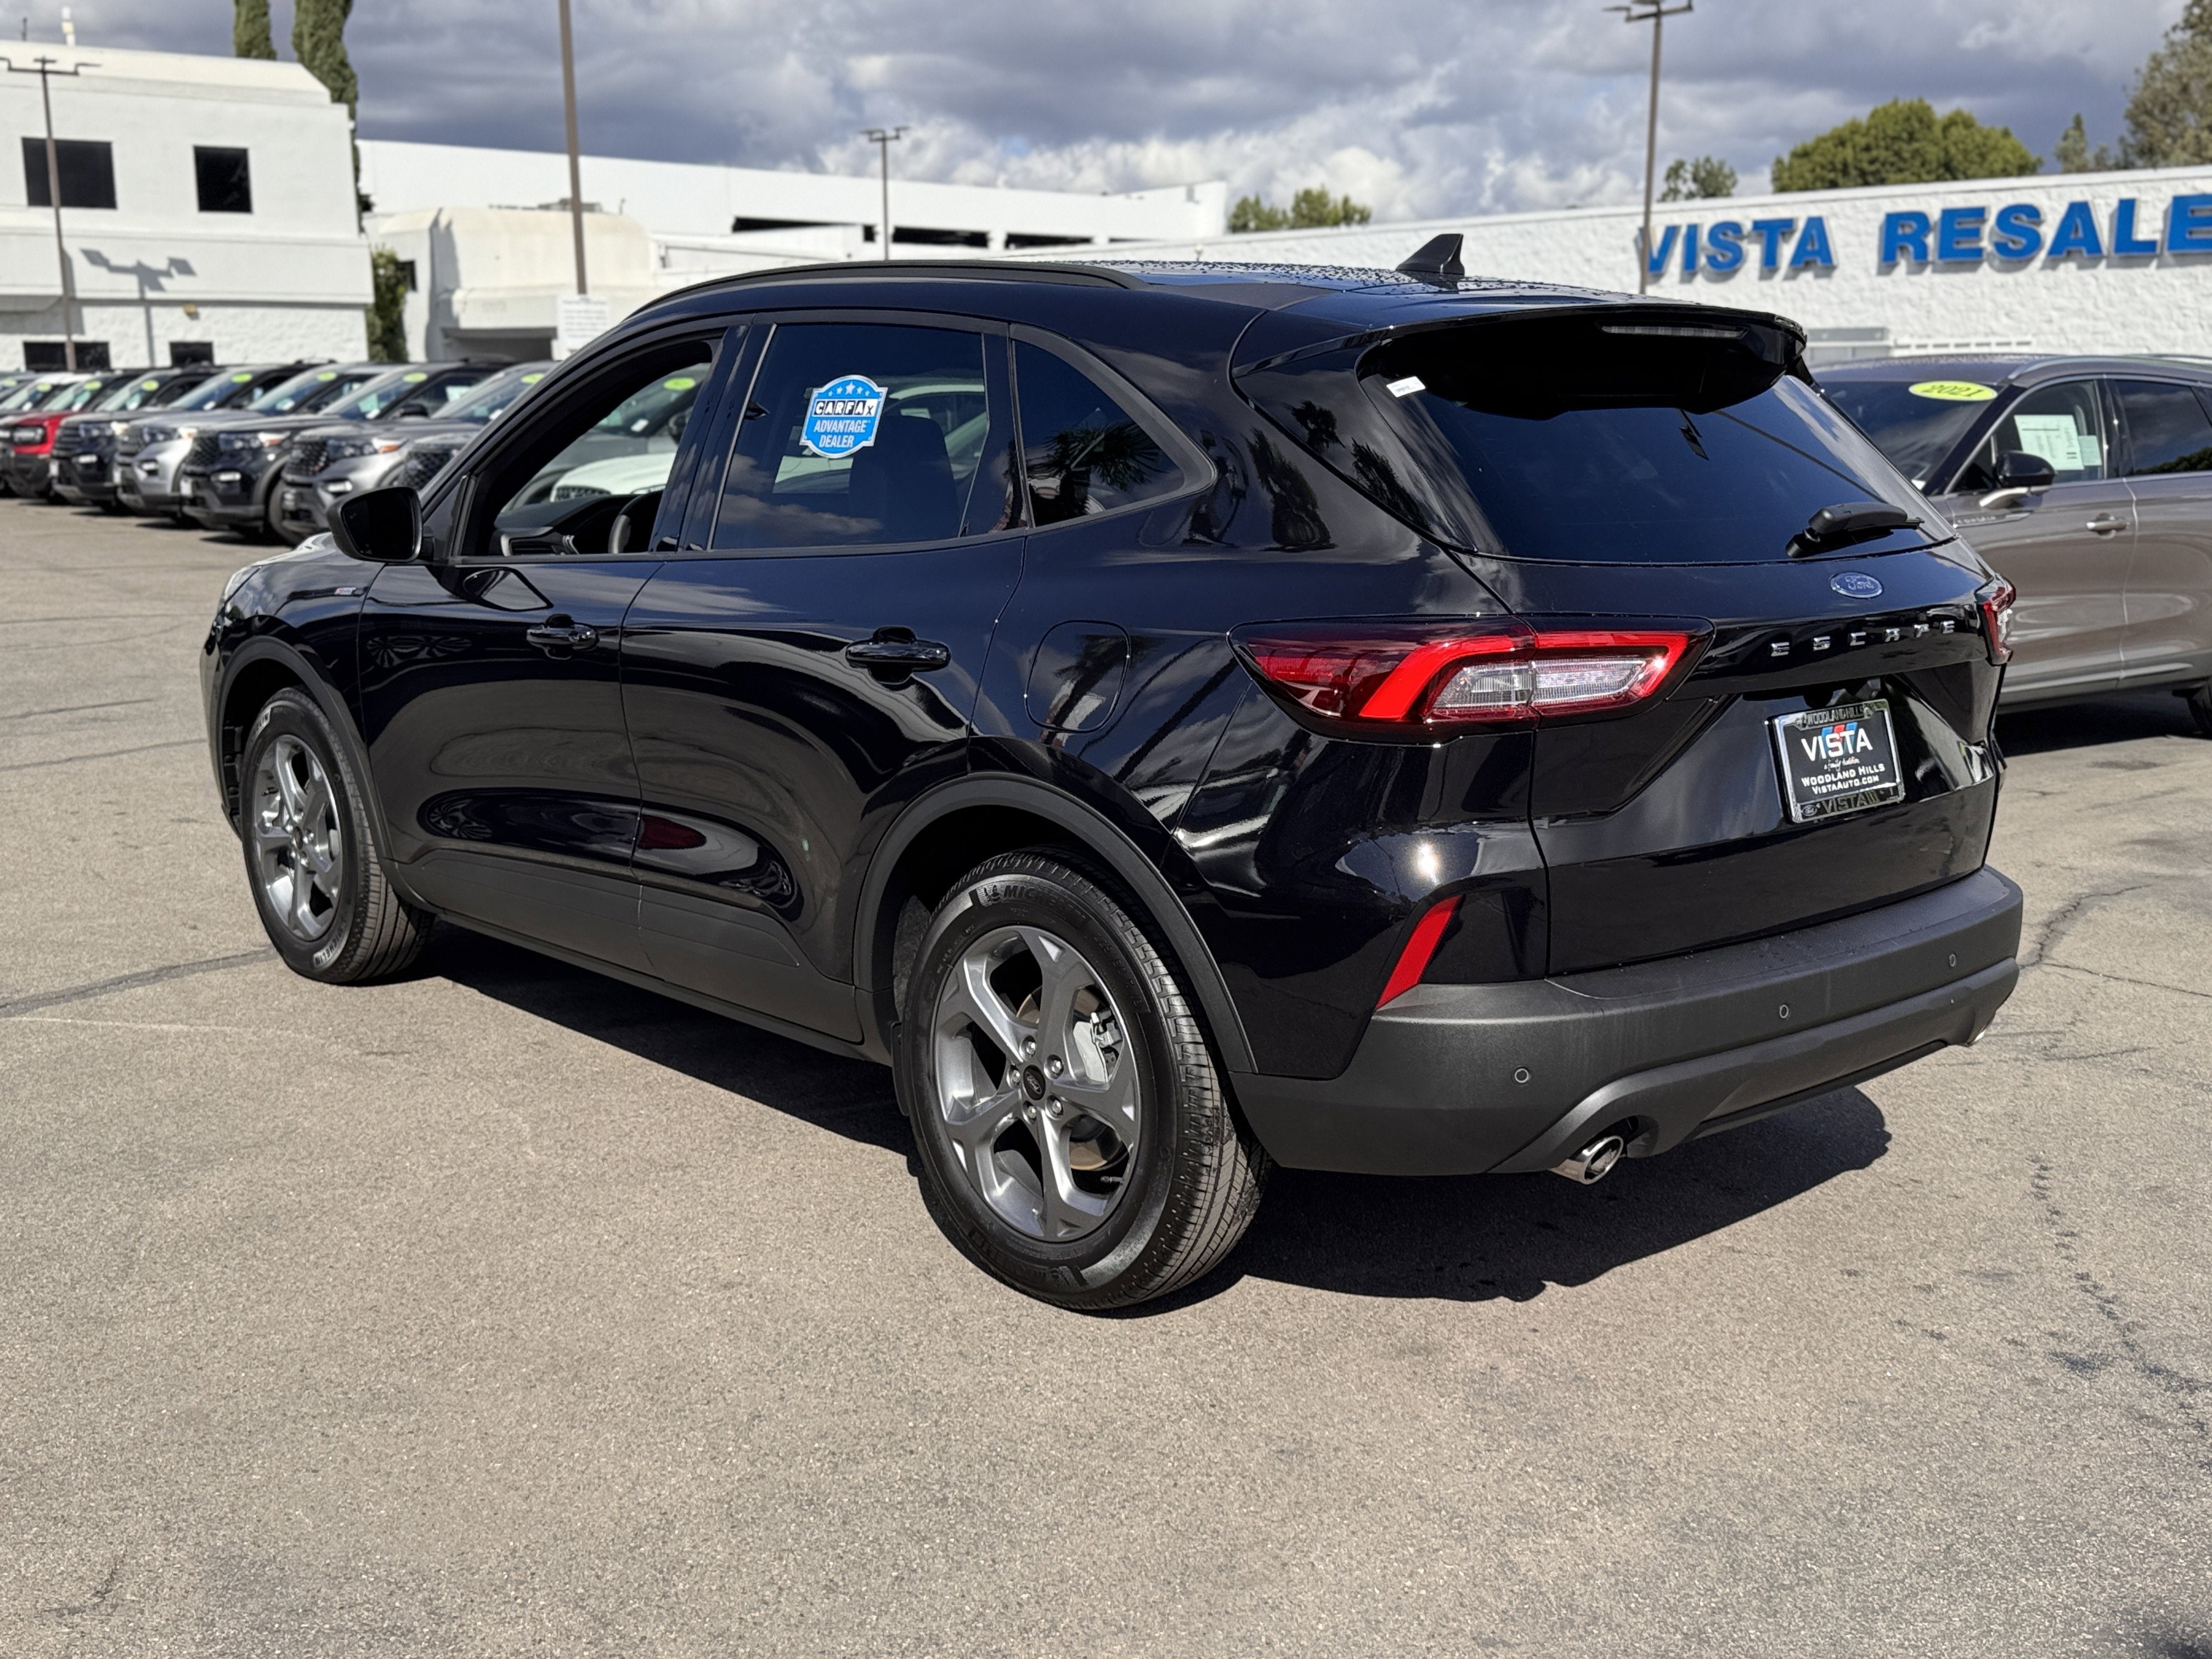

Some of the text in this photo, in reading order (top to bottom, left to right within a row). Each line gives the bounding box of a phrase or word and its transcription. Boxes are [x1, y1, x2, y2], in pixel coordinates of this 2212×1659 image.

[1638, 193, 2212, 273] VISTA RESALE
[1922, 384, 1985, 397] 2021
[814, 400, 874, 416] CARFAX
[813, 419, 867, 433] ADVANTAGE
[819, 435, 855, 448] DEALER
[1844, 575, 1875, 591] Ford
[1770, 620, 1955, 657] ESCAPE
[1801, 728, 1873, 761] VISTA
[1801, 763, 1886, 787] WOODLAND HILLS
